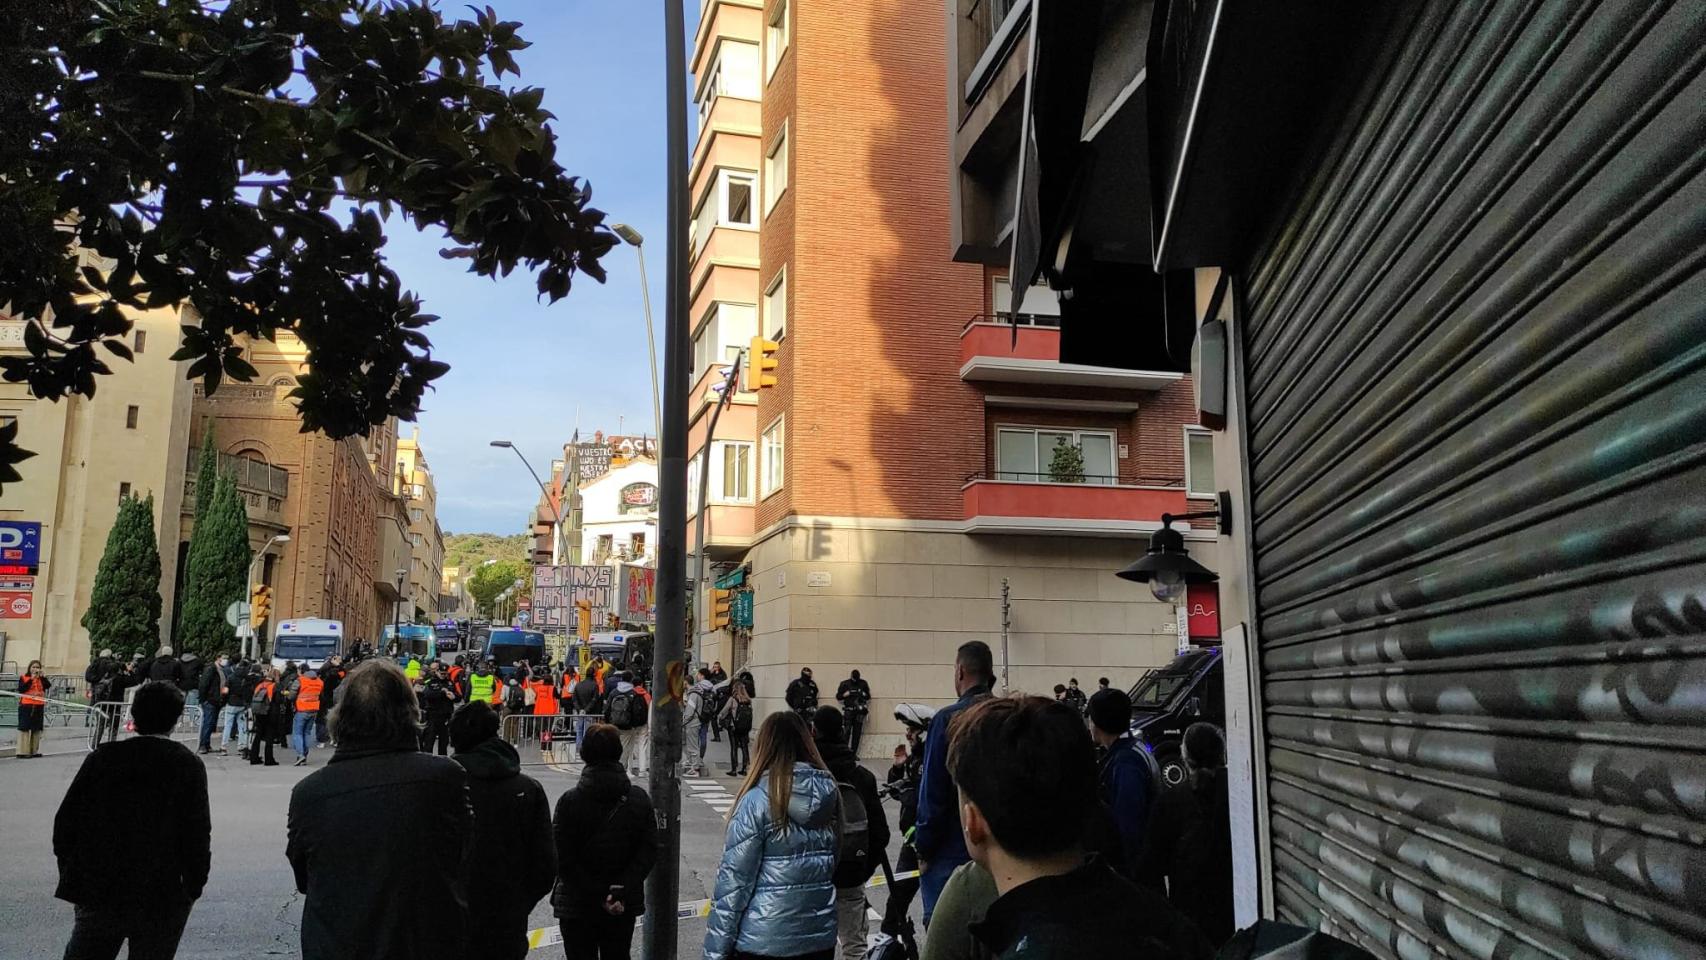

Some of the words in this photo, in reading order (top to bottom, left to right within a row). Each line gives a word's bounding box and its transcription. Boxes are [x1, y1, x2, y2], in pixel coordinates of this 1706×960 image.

[578, 447, 613, 457] VUESTRO
[597, 457, 607, 465] ES
[580, 464, 608, 472] NUESTRA
[533, 608, 559, 625] EL
